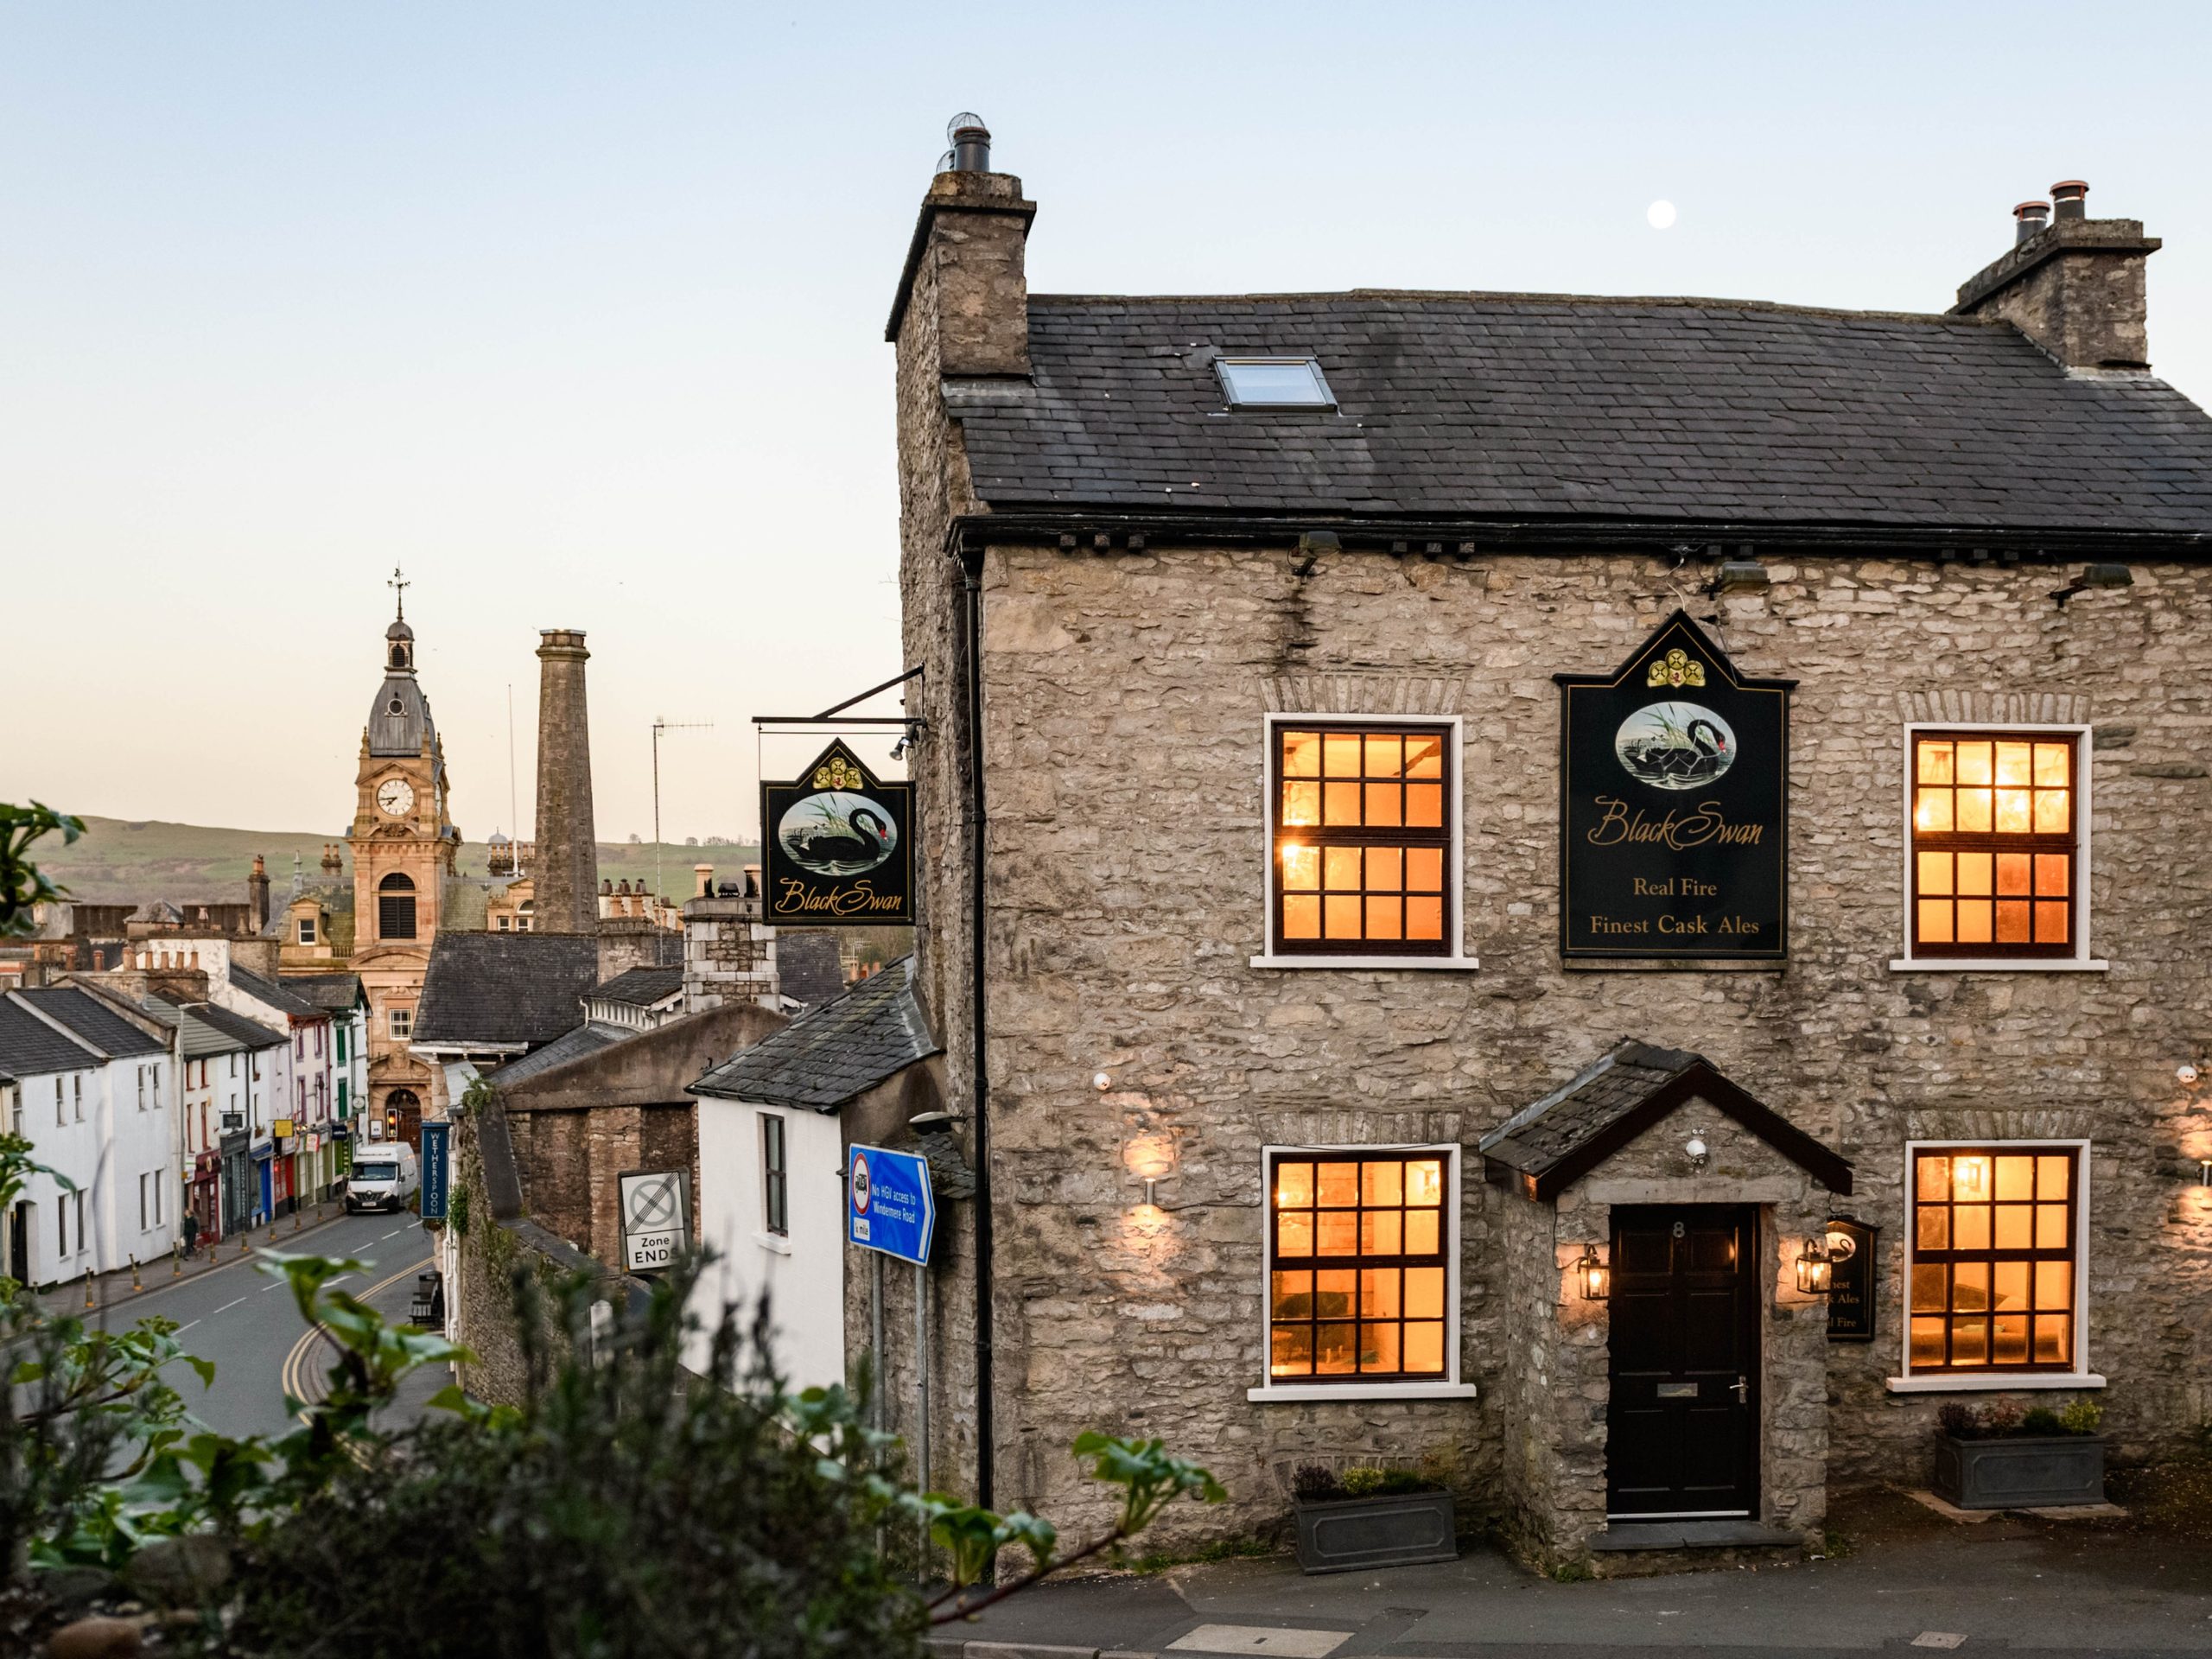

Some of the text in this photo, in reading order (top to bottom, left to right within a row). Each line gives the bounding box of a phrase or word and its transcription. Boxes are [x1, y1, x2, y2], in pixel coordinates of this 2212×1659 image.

[1587, 795, 1764, 851] Black Swan
[775, 877, 902, 916] Black Swan
[1633, 877, 1718, 897] Real Fire
[1590, 914, 1759, 934] Finest Cask Ales
[430, 1132, 440, 1215] WETHERSPOON
[872, 1183, 916, 1205] No HGV access to
[873, 1200, 915, 1224] Windermere Road
[1673, 1221, 1685, 1238] 8
[641, 1237, 670, 1248] Zone
[1838, 1294, 1859, 1304] Ales
[1837, 1317, 1857, 1327] Fire
